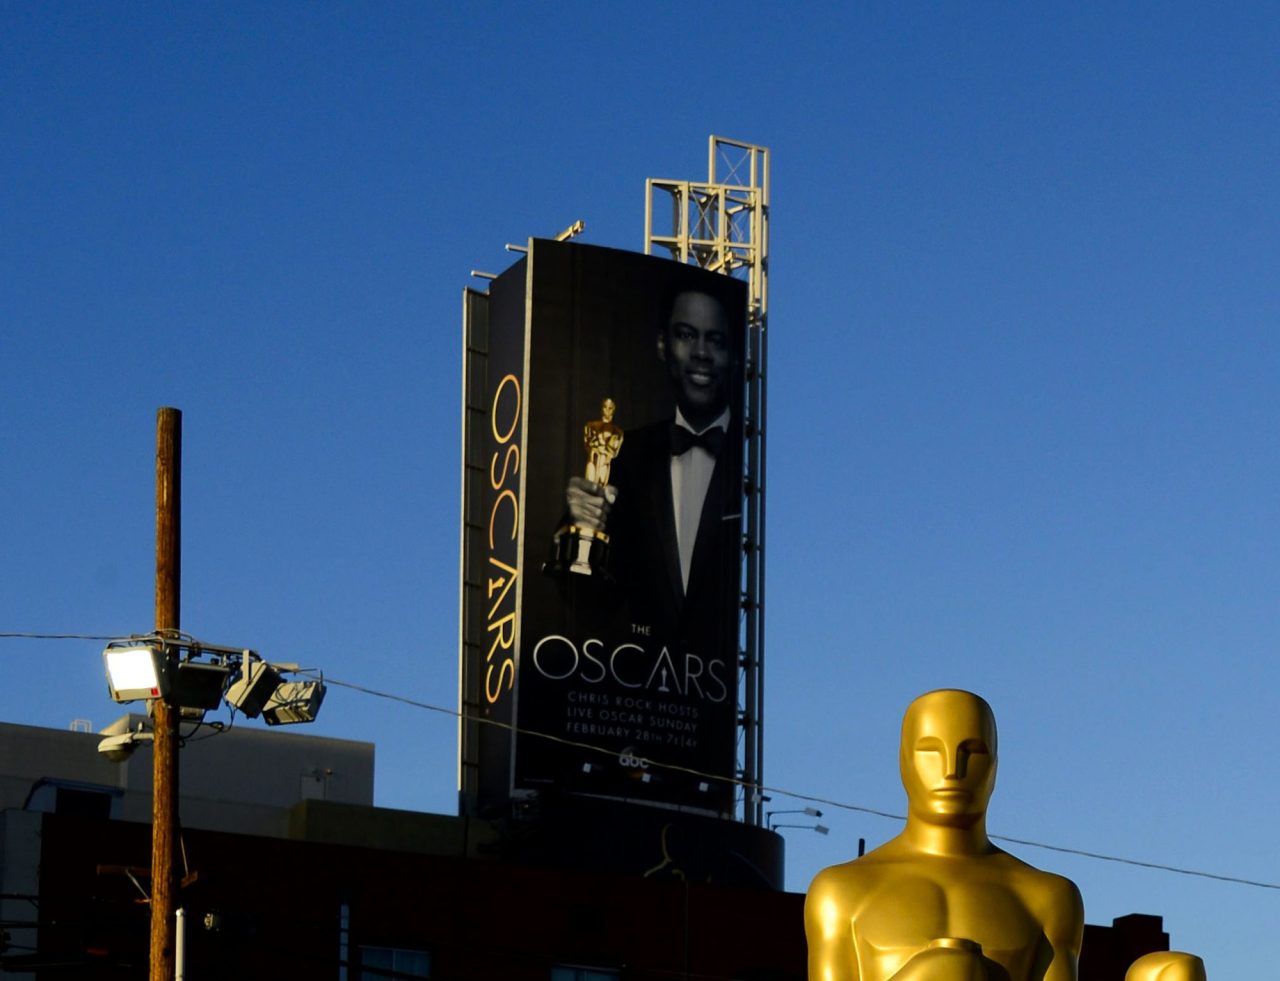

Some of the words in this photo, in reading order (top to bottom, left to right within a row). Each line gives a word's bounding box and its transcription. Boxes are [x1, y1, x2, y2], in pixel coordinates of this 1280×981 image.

[485, 373, 522, 706] OSCARS
[631, 623, 652, 636] THE
[533, 634, 728, 703] OSCARS
[567, 690, 609, 706] CHRIS
[615, 695, 653, 711] ROCK
[658, 701, 699, 720] HOSTS
[566, 706, 594, 720] LIVE
[599, 709, 645, 726] OSCAR
[650, 714, 698, 734] SUNDAY
[566, 721, 630, 739] FEBRUARY
[618, 751, 650, 770] abc
